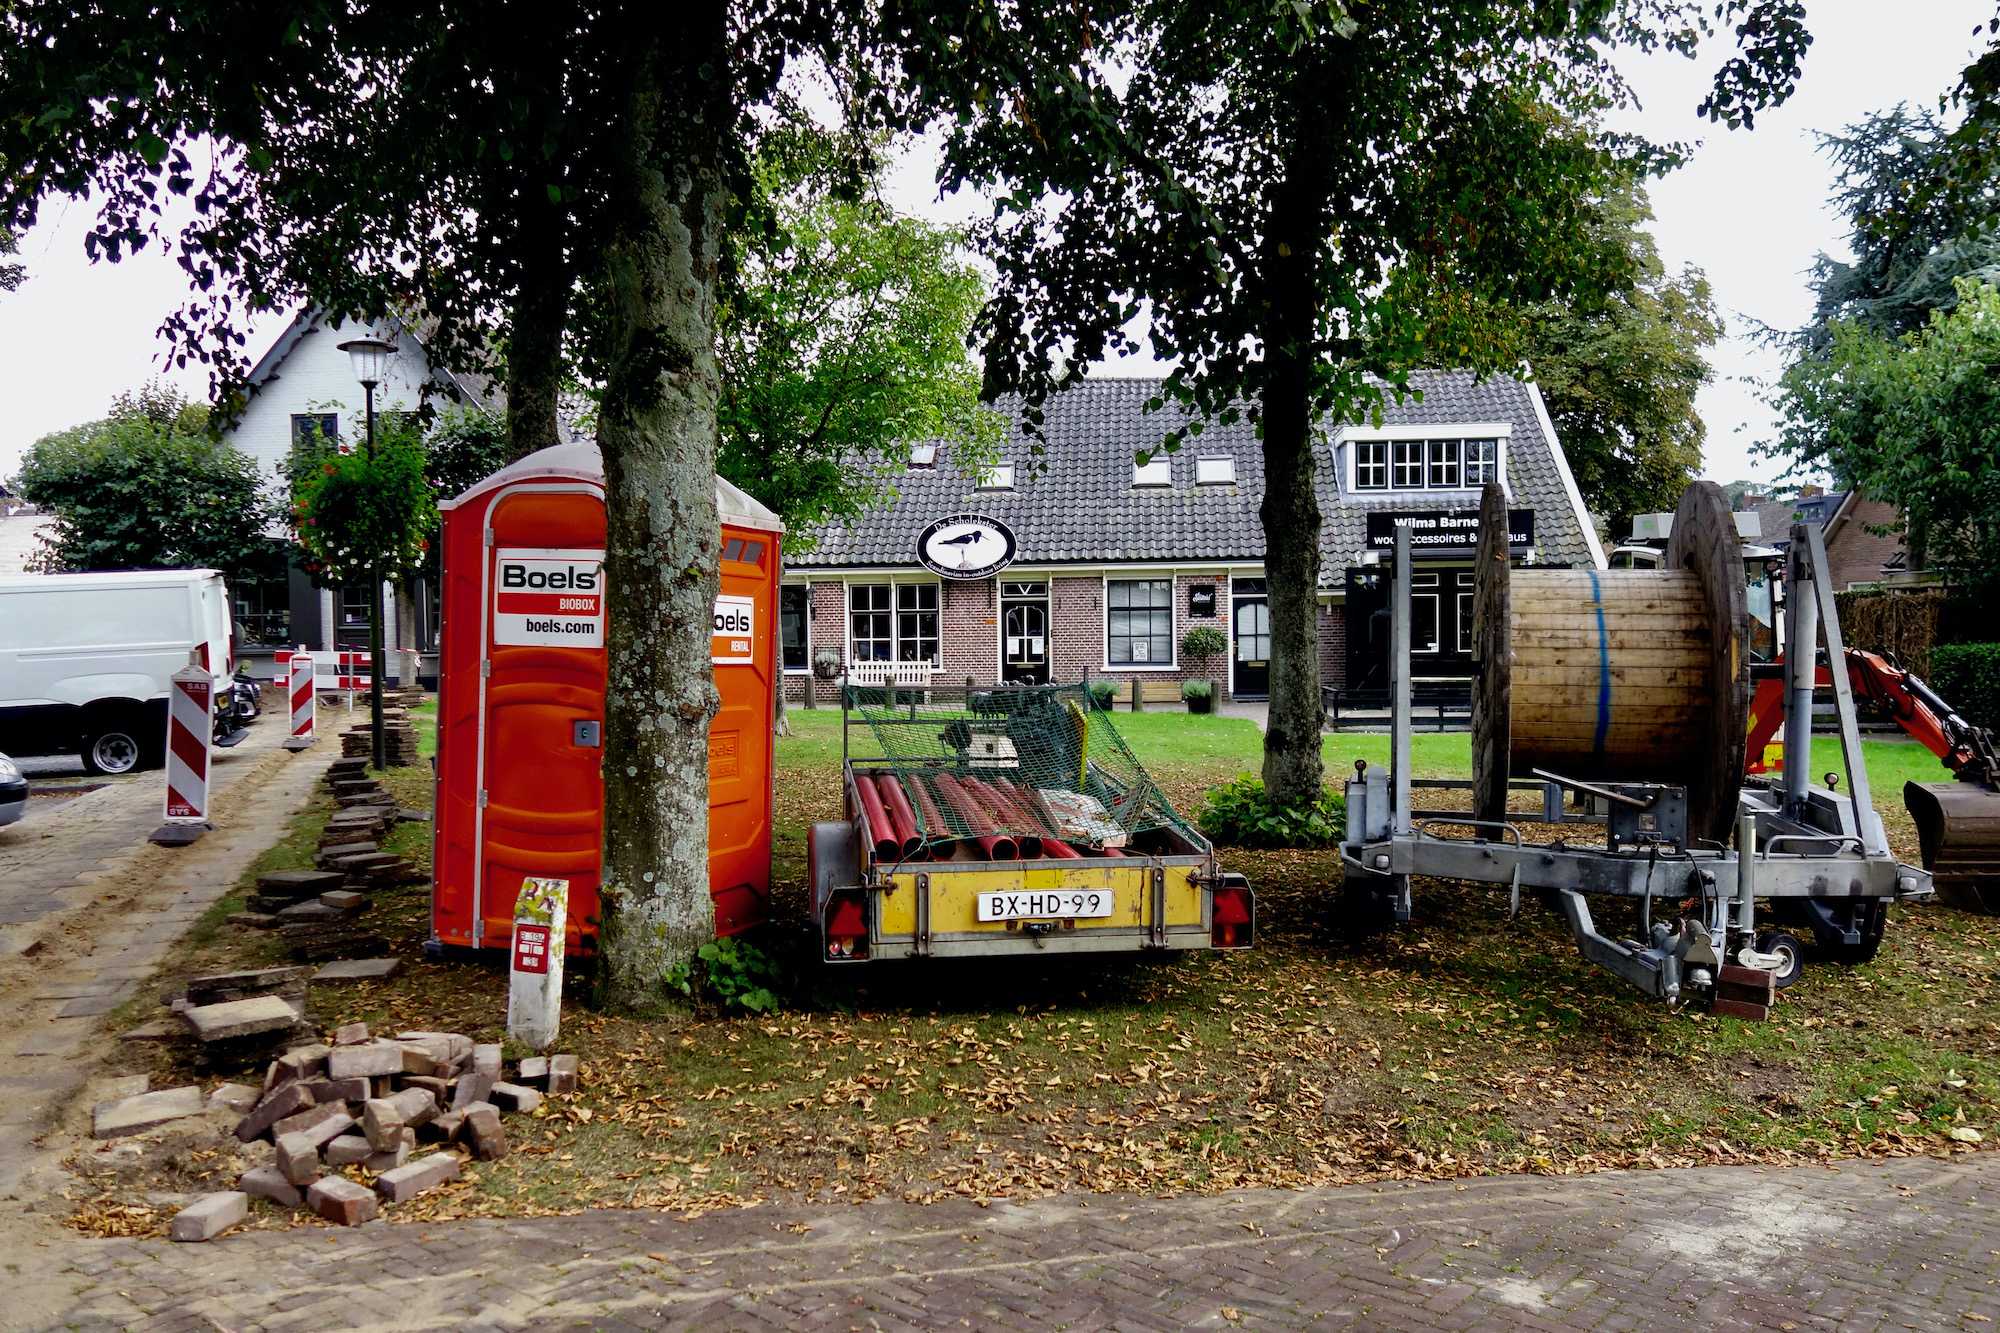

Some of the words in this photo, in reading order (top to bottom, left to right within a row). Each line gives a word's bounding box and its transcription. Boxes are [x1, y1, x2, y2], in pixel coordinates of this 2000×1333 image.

[933, 522, 947, 533] De
[948, 515, 998, 530] Scholekster
[1394, 518, 1437, 528] Wilma
[1440, 517, 1479, 528] Barne
[1469, 534, 1478, 543] &
[926, 560, 963, 578] Scandinavian
[993, 558, 1010, 571] living
[503, 564, 597, 590] Boels
[559, 598, 595, 611] BIOBOX
[526, 618, 595, 634] boels.com
[714, 608, 750, 632] oels
[169, 808, 190, 816] SAB
[992, 894, 1100, 916] BX-HD-99
